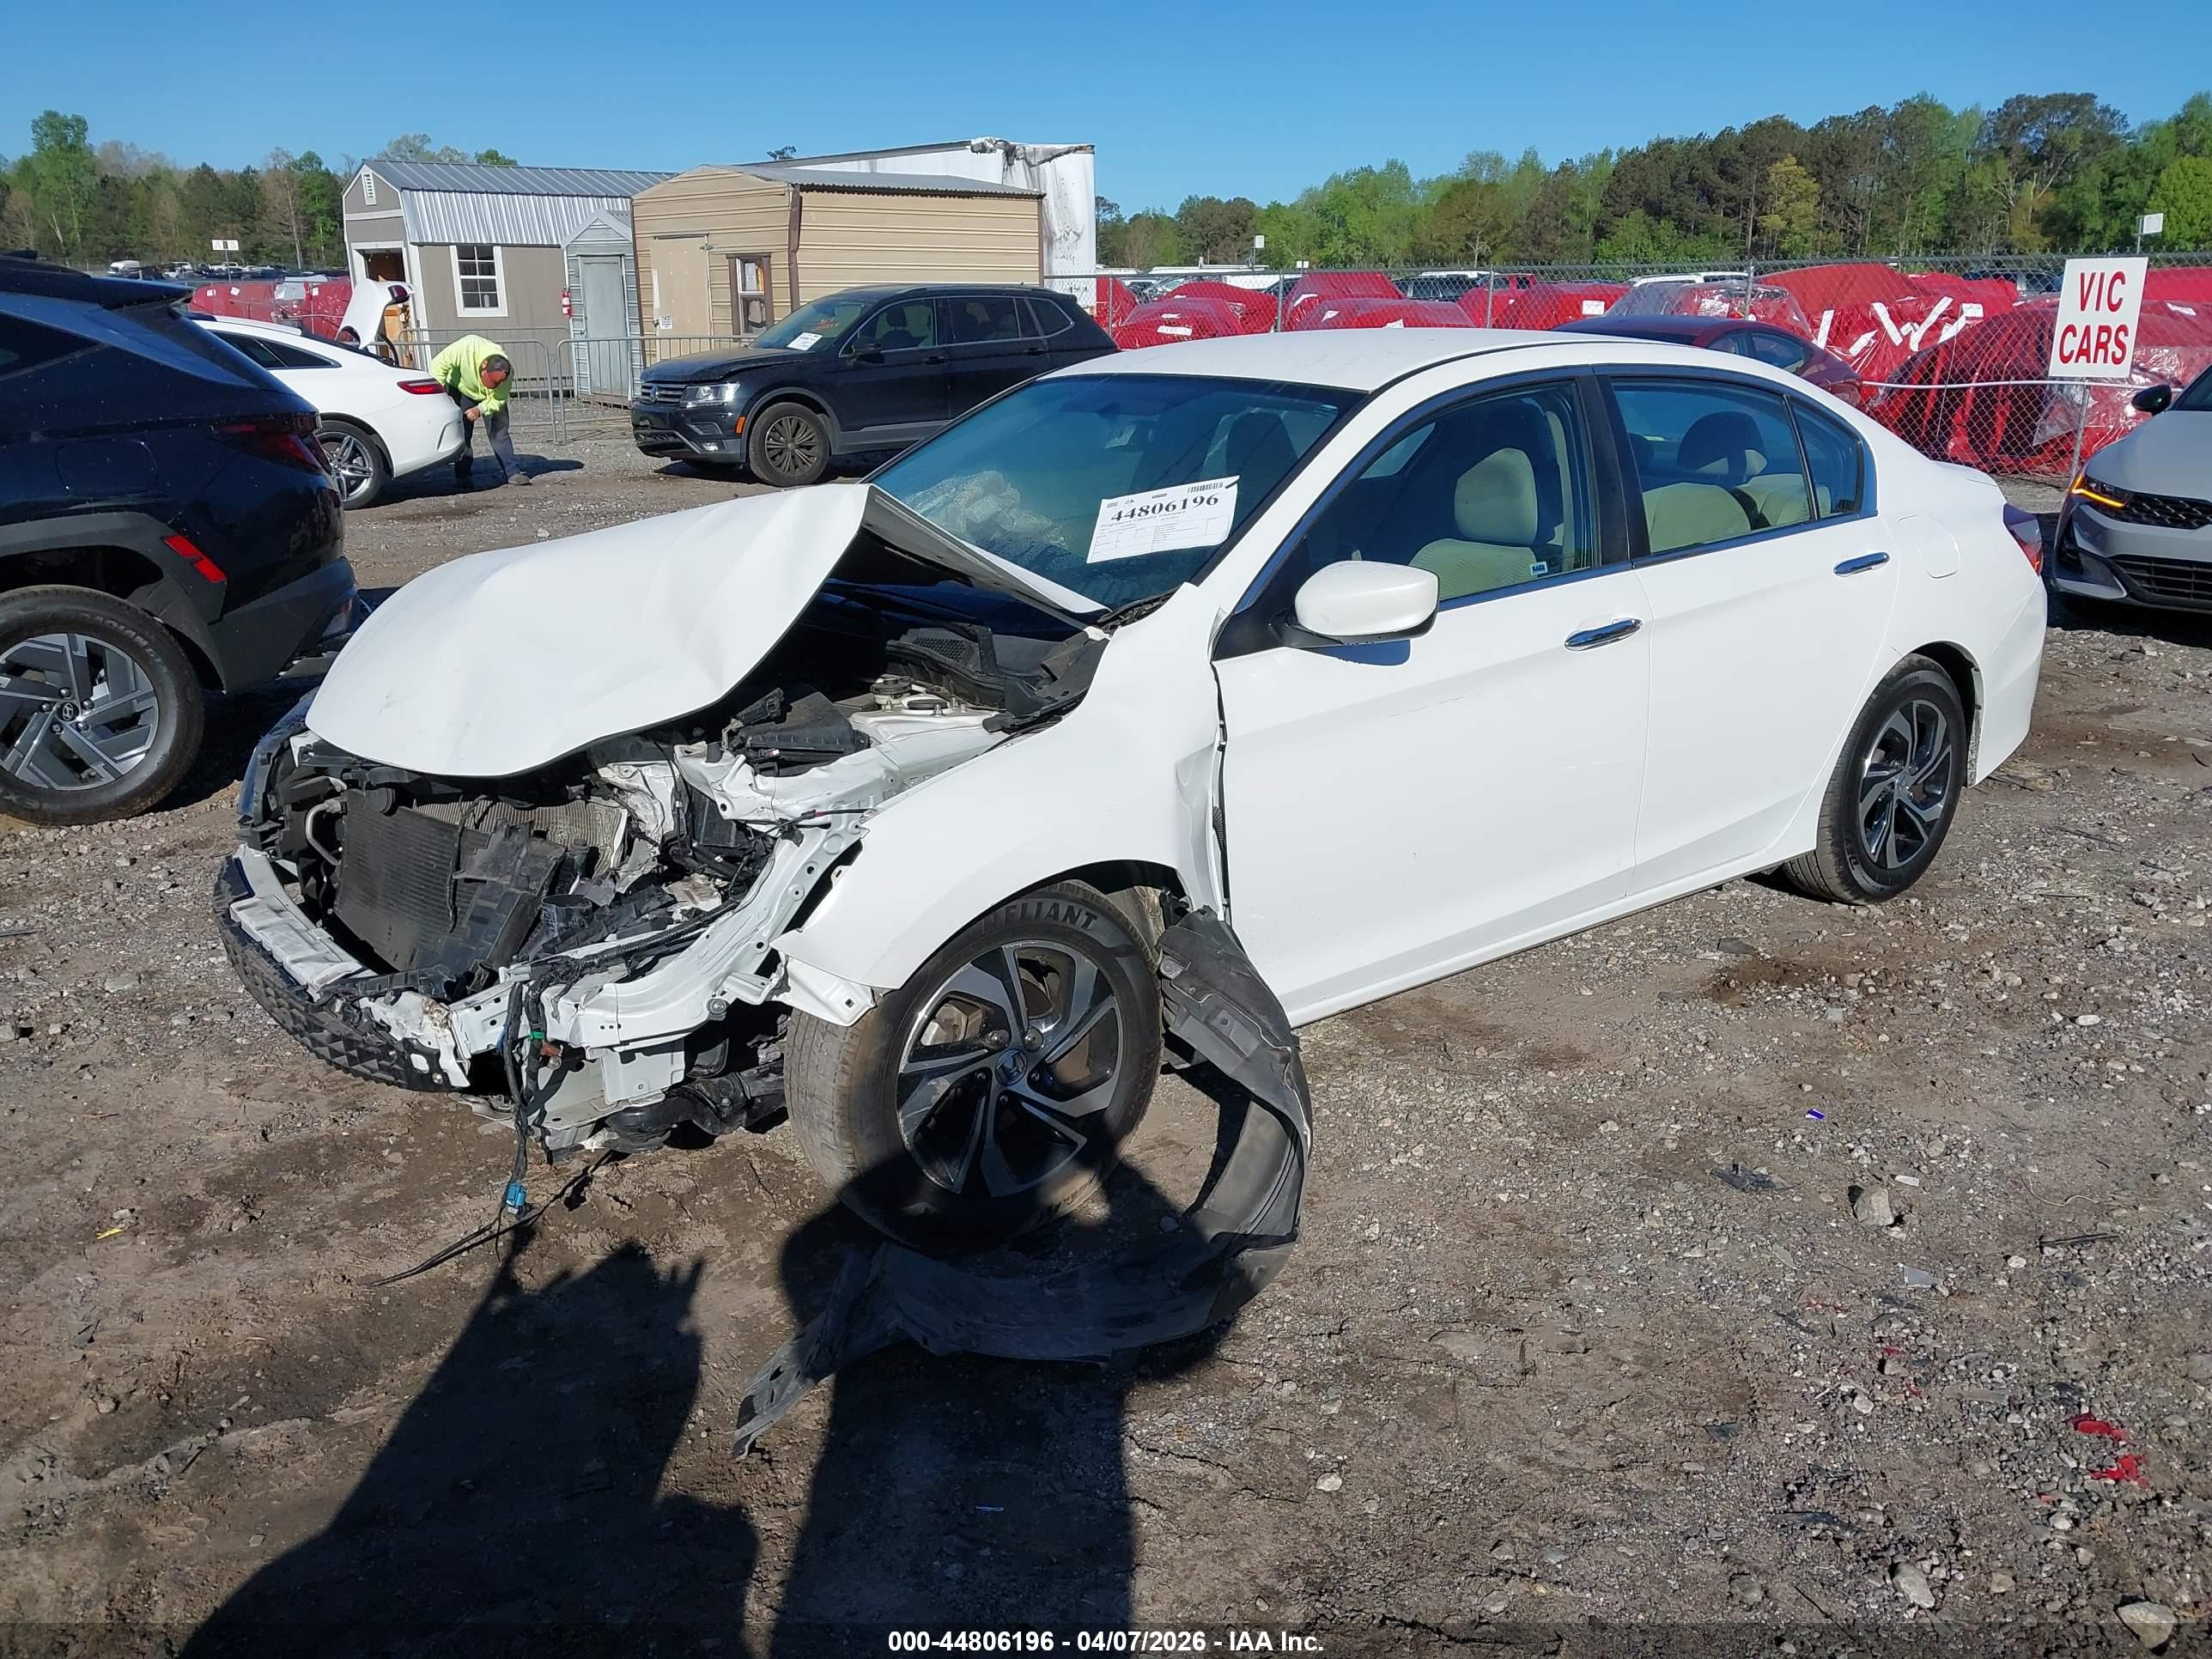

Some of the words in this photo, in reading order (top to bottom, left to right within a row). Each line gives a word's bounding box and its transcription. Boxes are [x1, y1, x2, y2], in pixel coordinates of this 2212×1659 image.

[2081, 270, 2126, 312] VIC
[2059, 324, 2129, 365] CARS
[1110, 492, 1220, 522] 44806196
